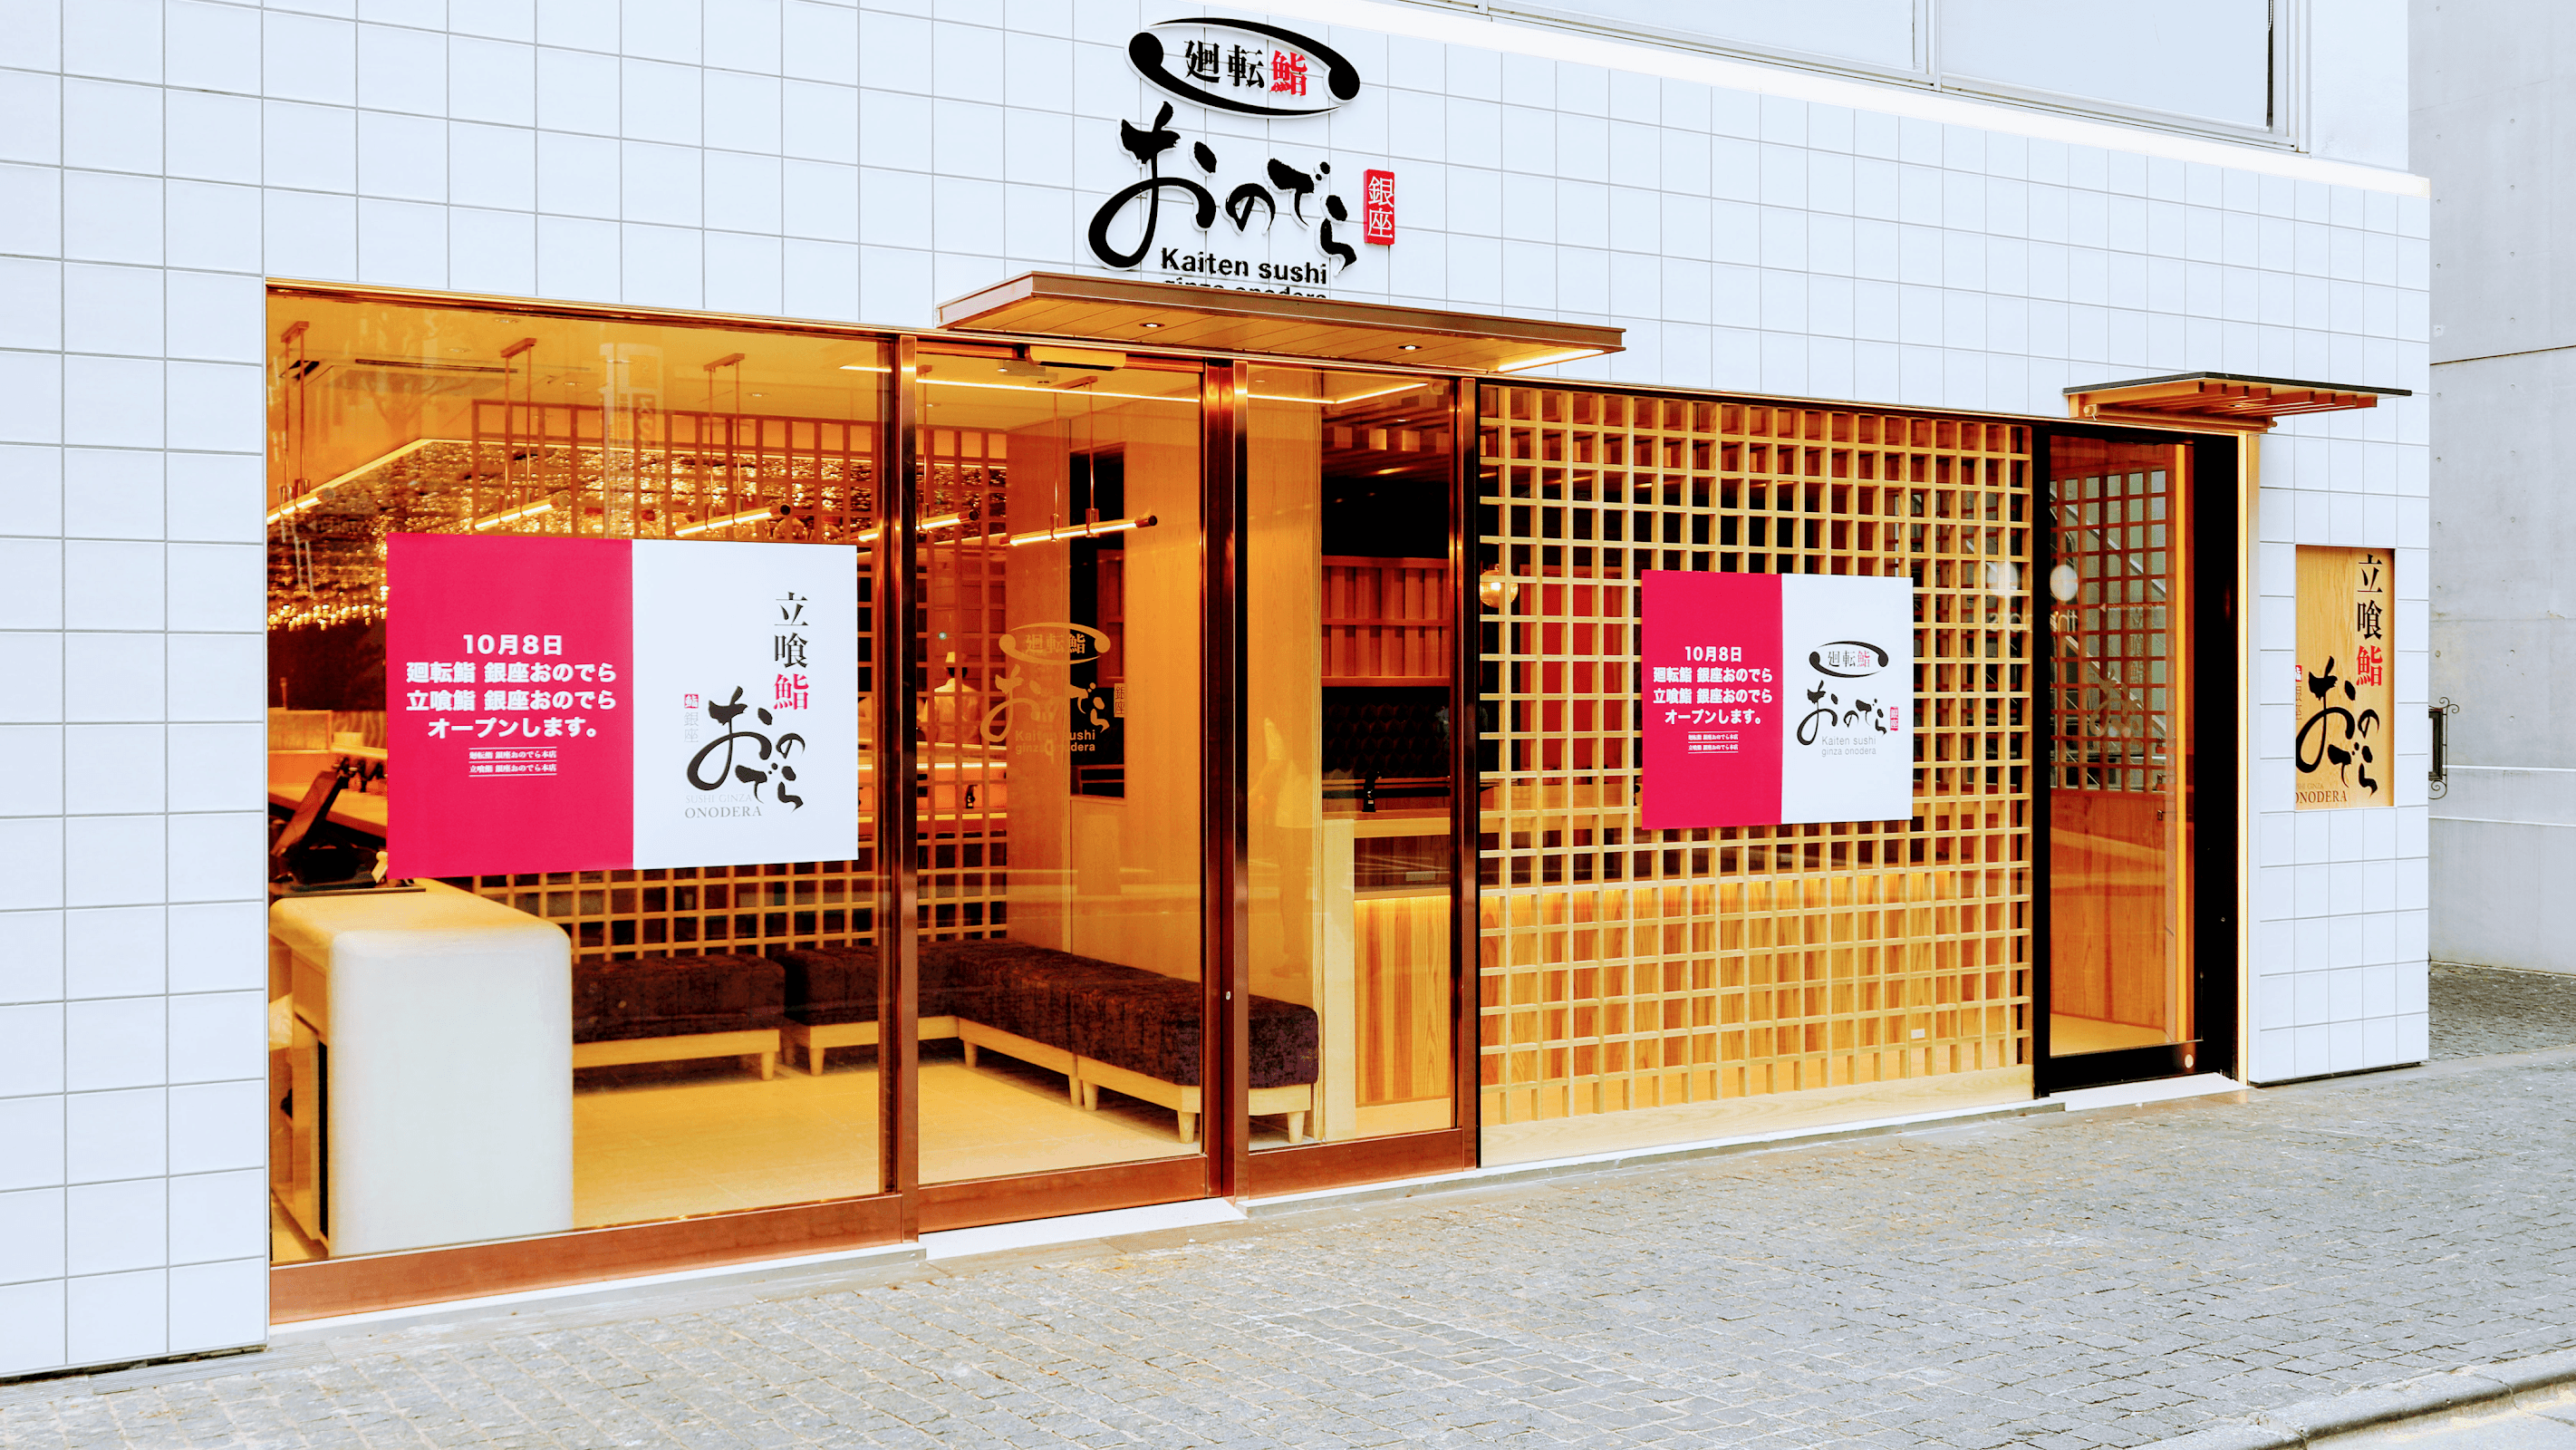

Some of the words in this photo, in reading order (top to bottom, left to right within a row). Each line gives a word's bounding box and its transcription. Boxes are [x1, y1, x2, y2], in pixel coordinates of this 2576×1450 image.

[1183, 39, 1307, 97] 廻転鮨
[1087, 101, 1358, 276] おのでら
[1366, 175, 1394, 240] 銀座
[1162, 247, 1249, 277] Kaiten
[1258, 262, 1327, 285] sushi
[463, 633, 563, 656] 10月8日
[1684, 646, 1741, 662] 10月8日
[406, 662, 476, 684] 廻転鮨
[484, 662, 616, 683] 銀座おのでら
[1696, 666, 1773, 683] 銀座おのでら
[406, 690, 476, 712] 立喰鮨
[484, 690, 616, 711] 銀座おのでら
[1696, 687, 1773, 704] 銀座おのでら
[1664, 708, 1761, 725] オープンします。
[1796, 680, 1887, 746] おのでら
[427, 716, 597, 740] オープンします。
[1061, 730, 1095, 740] ushi
[1821, 735, 1850, 746] Kaiten
[1853, 735, 1877, 746] sushi
[1821, 747, 1843, 758] ginza
[1845, 747, 1877, 755] onodera
[686, 794, 715, 805] SUSHI
[719, 793, 753, 804] GINZA
[684, 806, 763, 819] ONODERA
